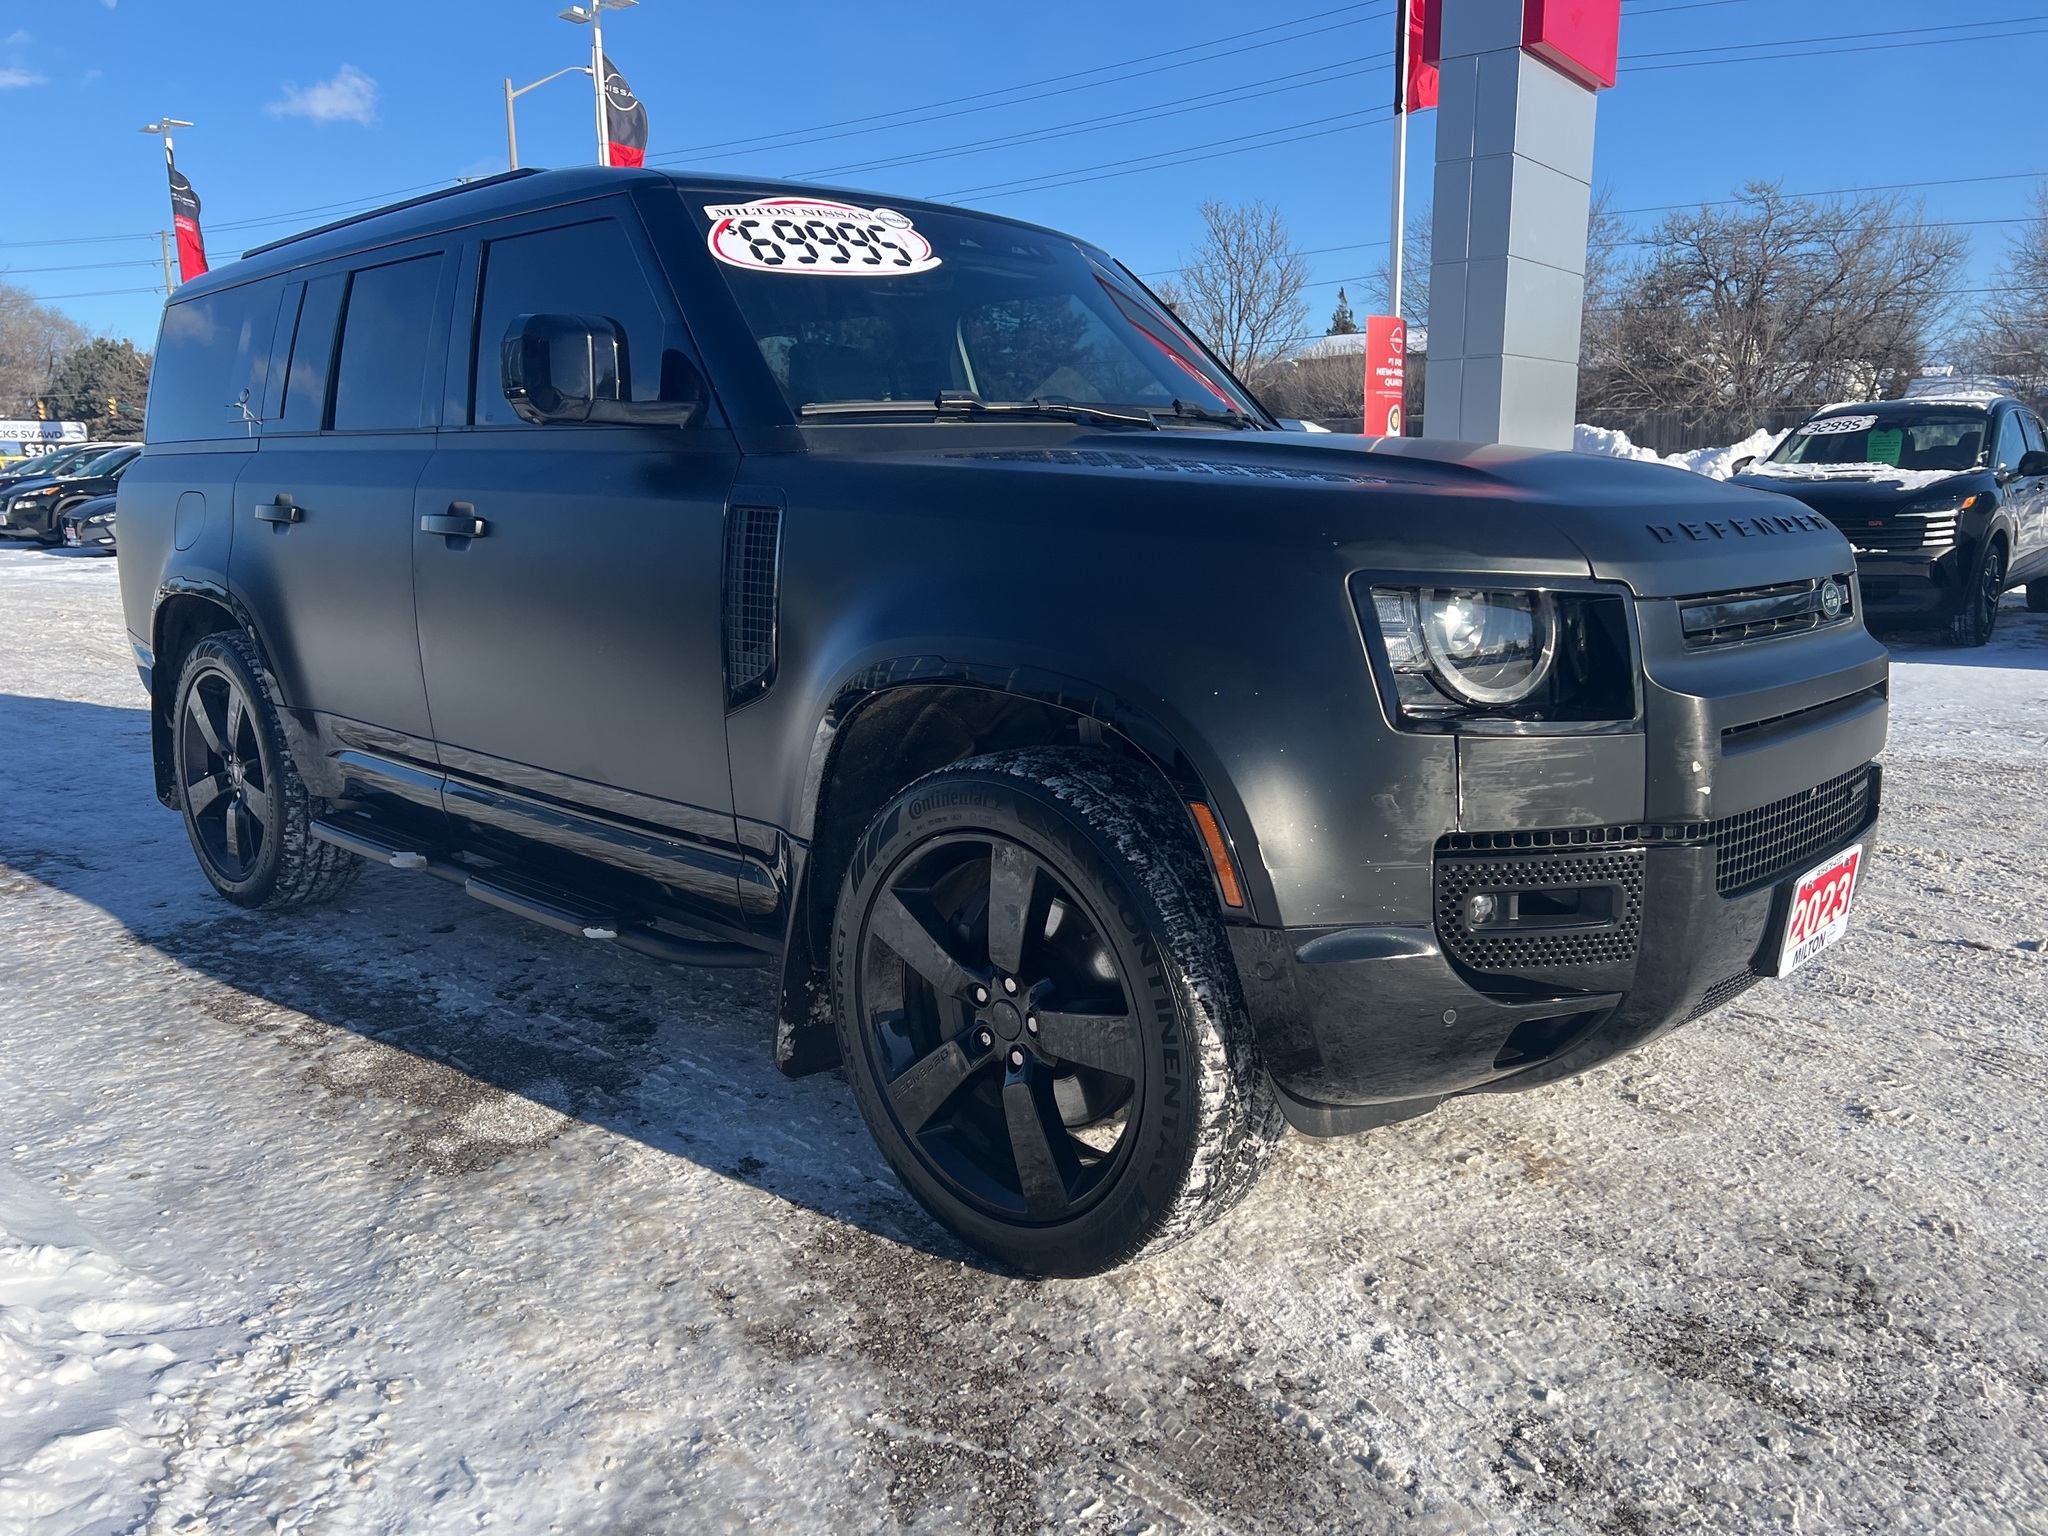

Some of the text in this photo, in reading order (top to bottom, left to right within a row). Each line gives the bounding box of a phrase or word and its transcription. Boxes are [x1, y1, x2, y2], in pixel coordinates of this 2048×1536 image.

[604, 85, 634, 98] NISSA
[714, 207, 873, 222] MILTON NISSAN
[20, 430, 35, 439] SV
[37, 430, 62, 439] AWD
[1646, 514, 1829, 544] DEFENDER
[908, 790, 988, 821] Continental
[1787, 871, 1851, 948] 2023
[1792, 931, 1827, 968] MILTON
[1102, 879, 1182, 1182] CONTINENTAL
